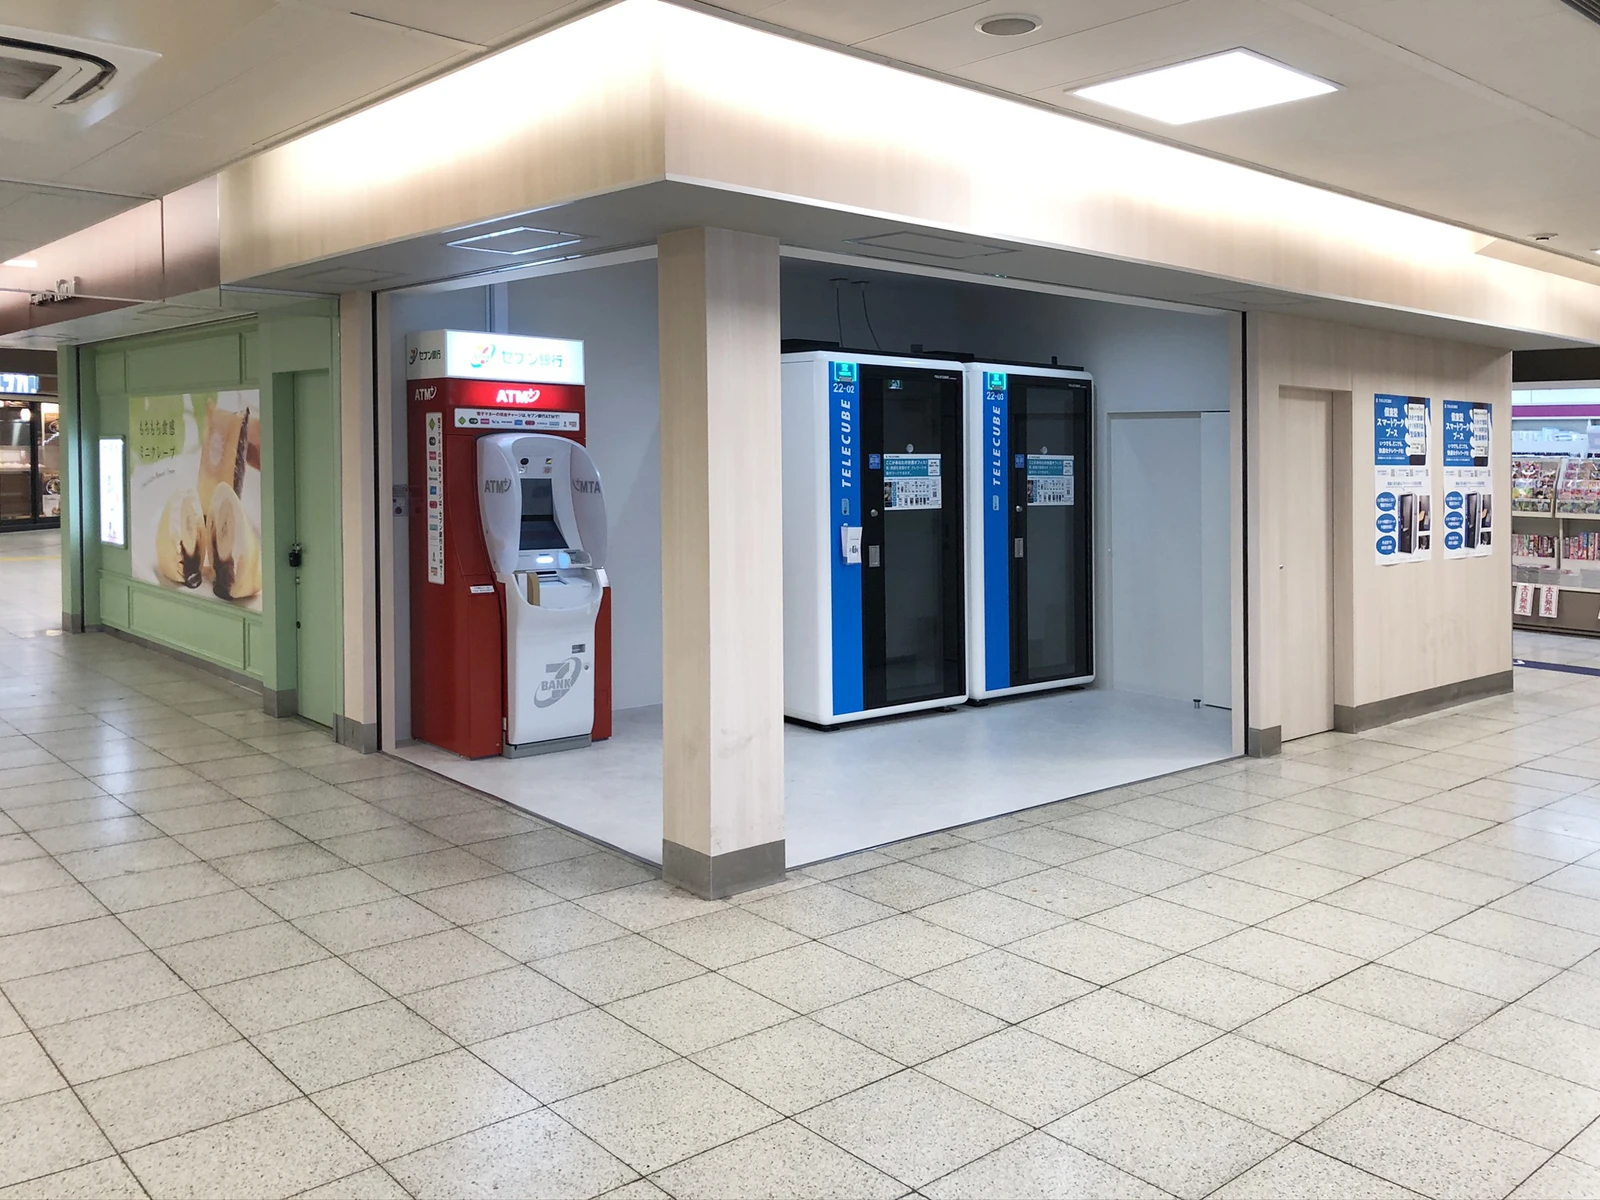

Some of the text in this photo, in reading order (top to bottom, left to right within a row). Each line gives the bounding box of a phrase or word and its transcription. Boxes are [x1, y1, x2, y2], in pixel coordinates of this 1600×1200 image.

[419, 349, 441, 361] セブン銀行
[501, 351, 563, 368] セブン銀行
[415, 387, 432, 401] ATM
[833, 383, 855, 394] 22-02
[496, 389, 530, 404] ATM
[986, 391, 1004, 401] 22-03
[139, 419, 176, 436] もちもち食感
[1376, 418, 1405, 427] スマートワーク
[1445, 423, 1470, 432] スマートワーク
[1385, 428, 1398, 437] ブース
[1453, 432, 1464, 440] ブース
[841, 399, 852, 488] TELECUBE
[992, 406, 1001, 486] TELECUBE
[139, 445, 176, 459] ミニクレープ
[484, 479, 505, 494] ATM
[1519, 585, 1529, 613] 本日発売
[1544, 586, 1554, 615] 本日発売
[541, 678, 571, 691] BANK
